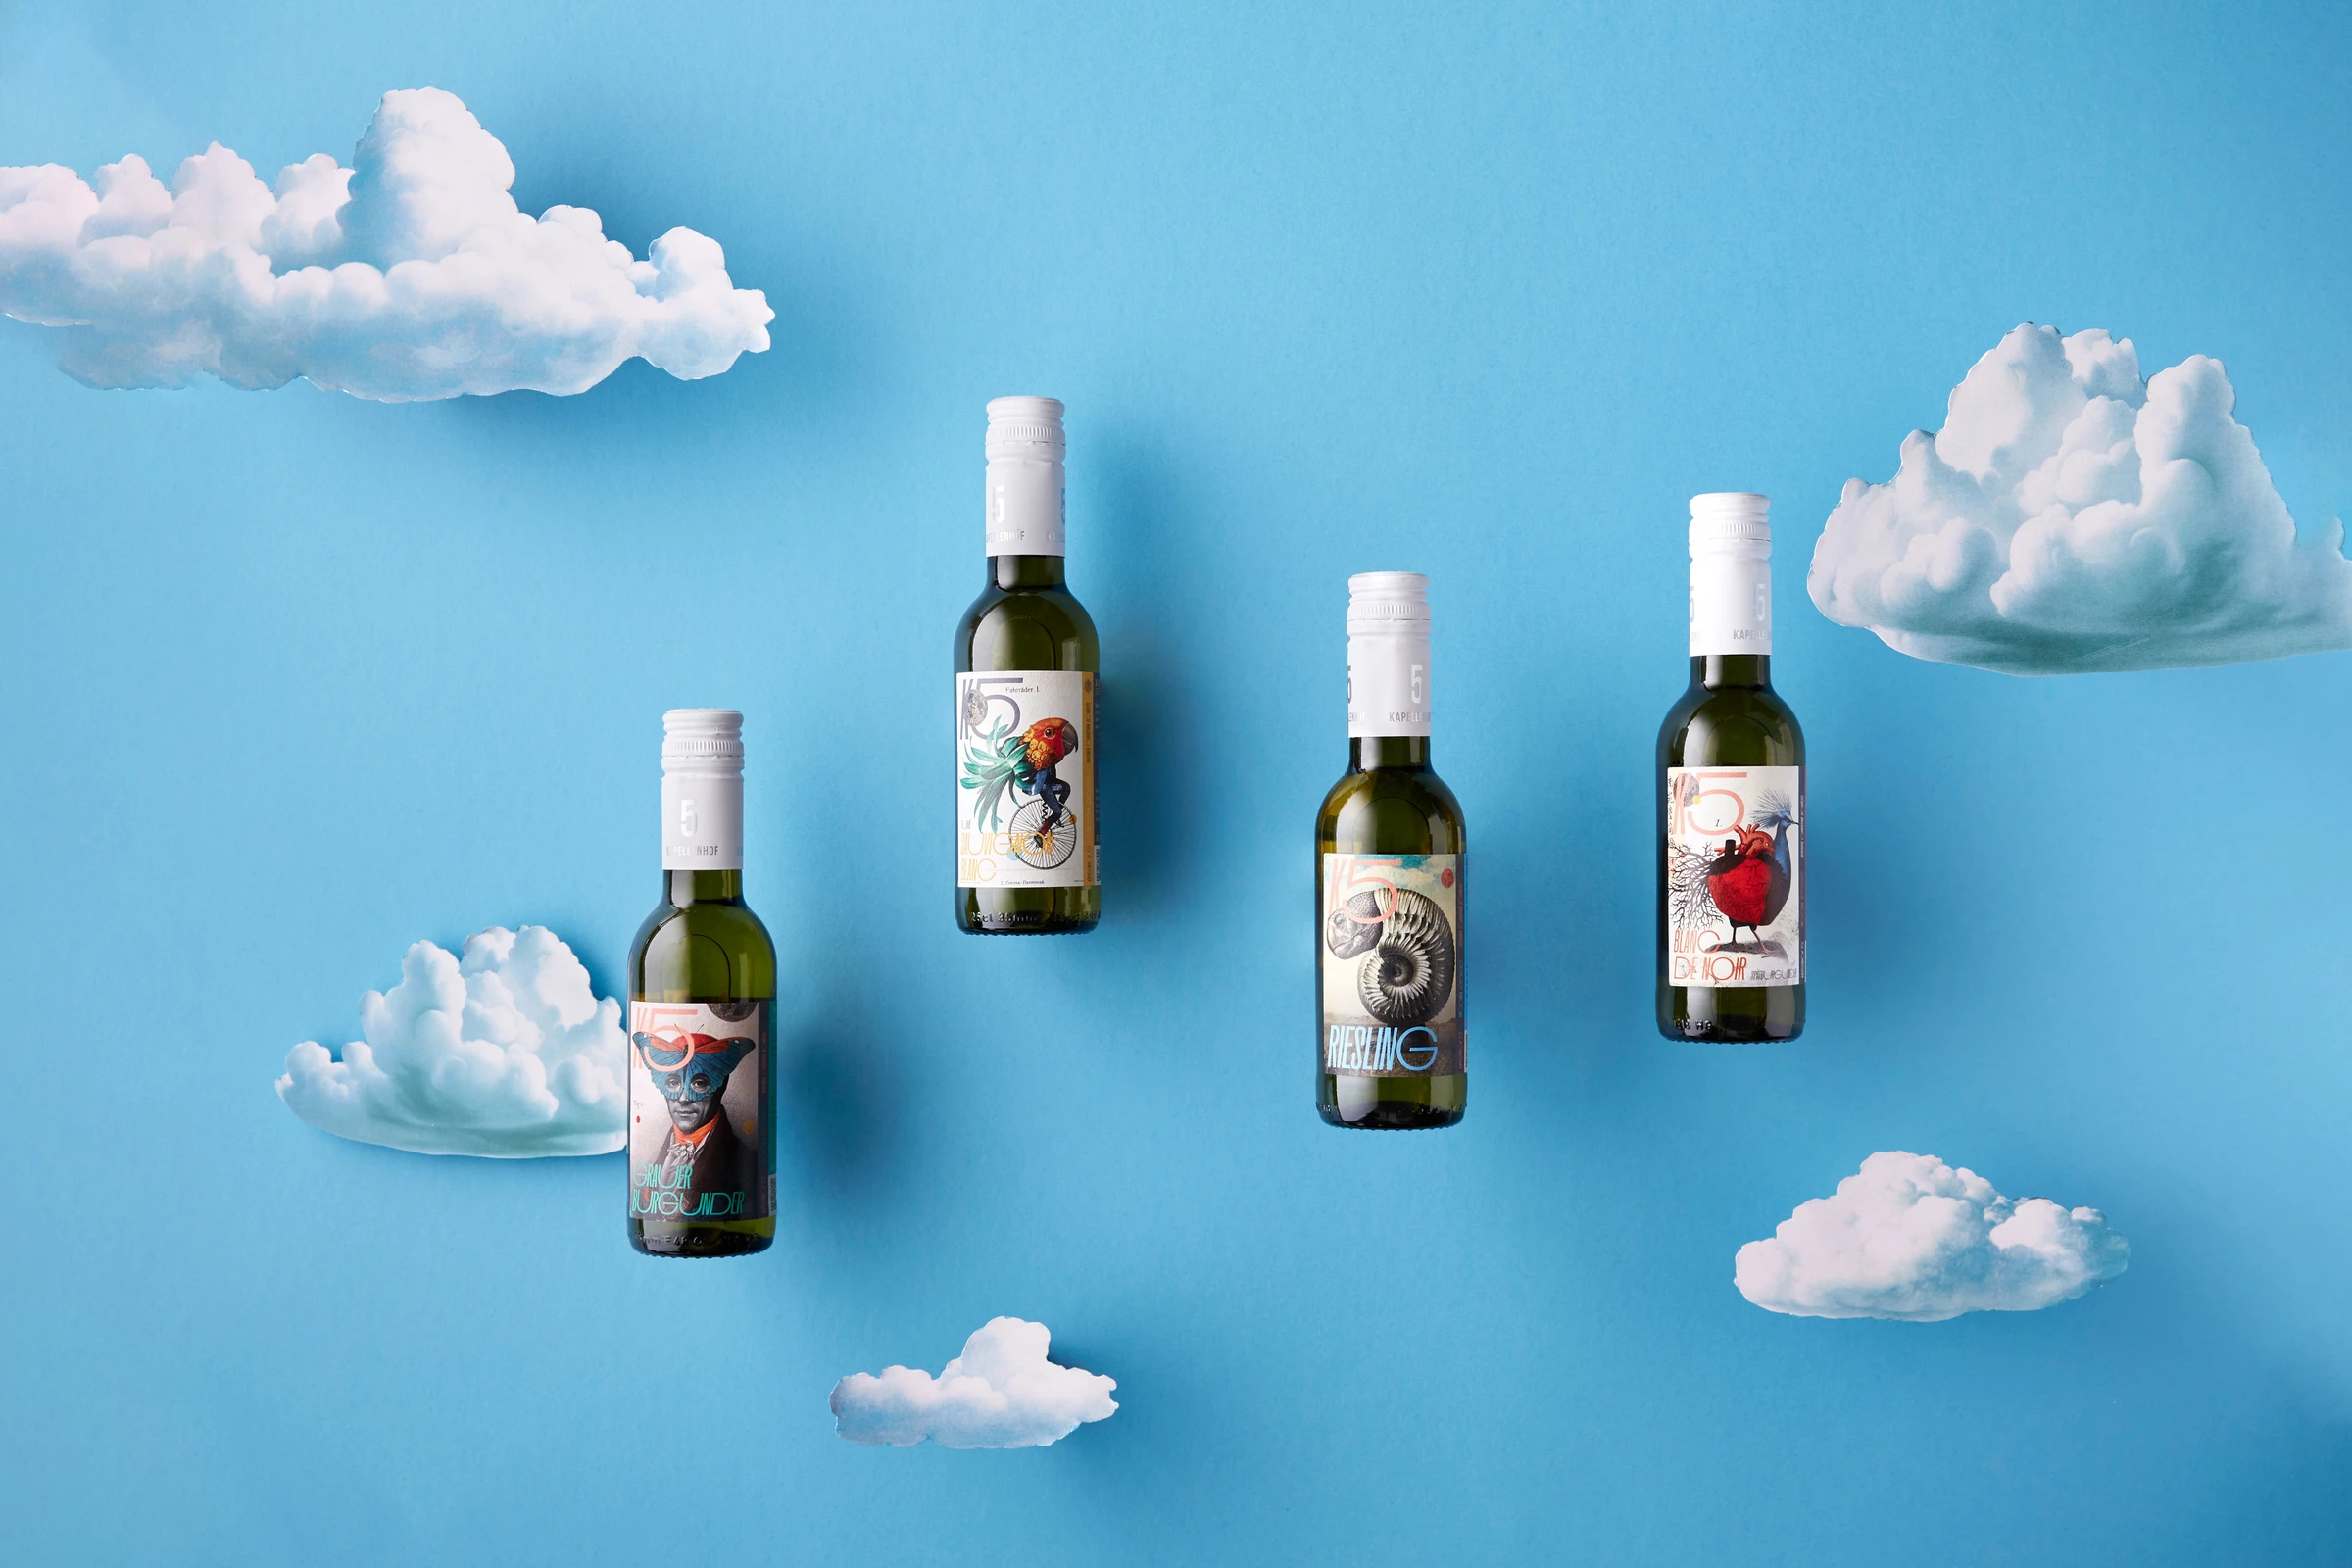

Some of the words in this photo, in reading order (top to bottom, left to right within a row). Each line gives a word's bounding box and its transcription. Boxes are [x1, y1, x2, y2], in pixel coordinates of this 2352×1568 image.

[993, 486, 1005, 524] 5
[1752, 583, 1766, 622] 5
[1411, 664, 1423, 704] 5
[680, 798, 698, 838] 5
[960, 858, 997, 882] BLANC
[1673, 930, 1720, 954] BLANC
[1673, 956, 1697, 980] DE
[1701, 956, 1747, 981] NOIR
[1327, 1025, 1438, 1071] RIESLING
[633, 1161, 693, 1190] GRAUER
[631, 1188, 746, 1216] BURGUNDER
